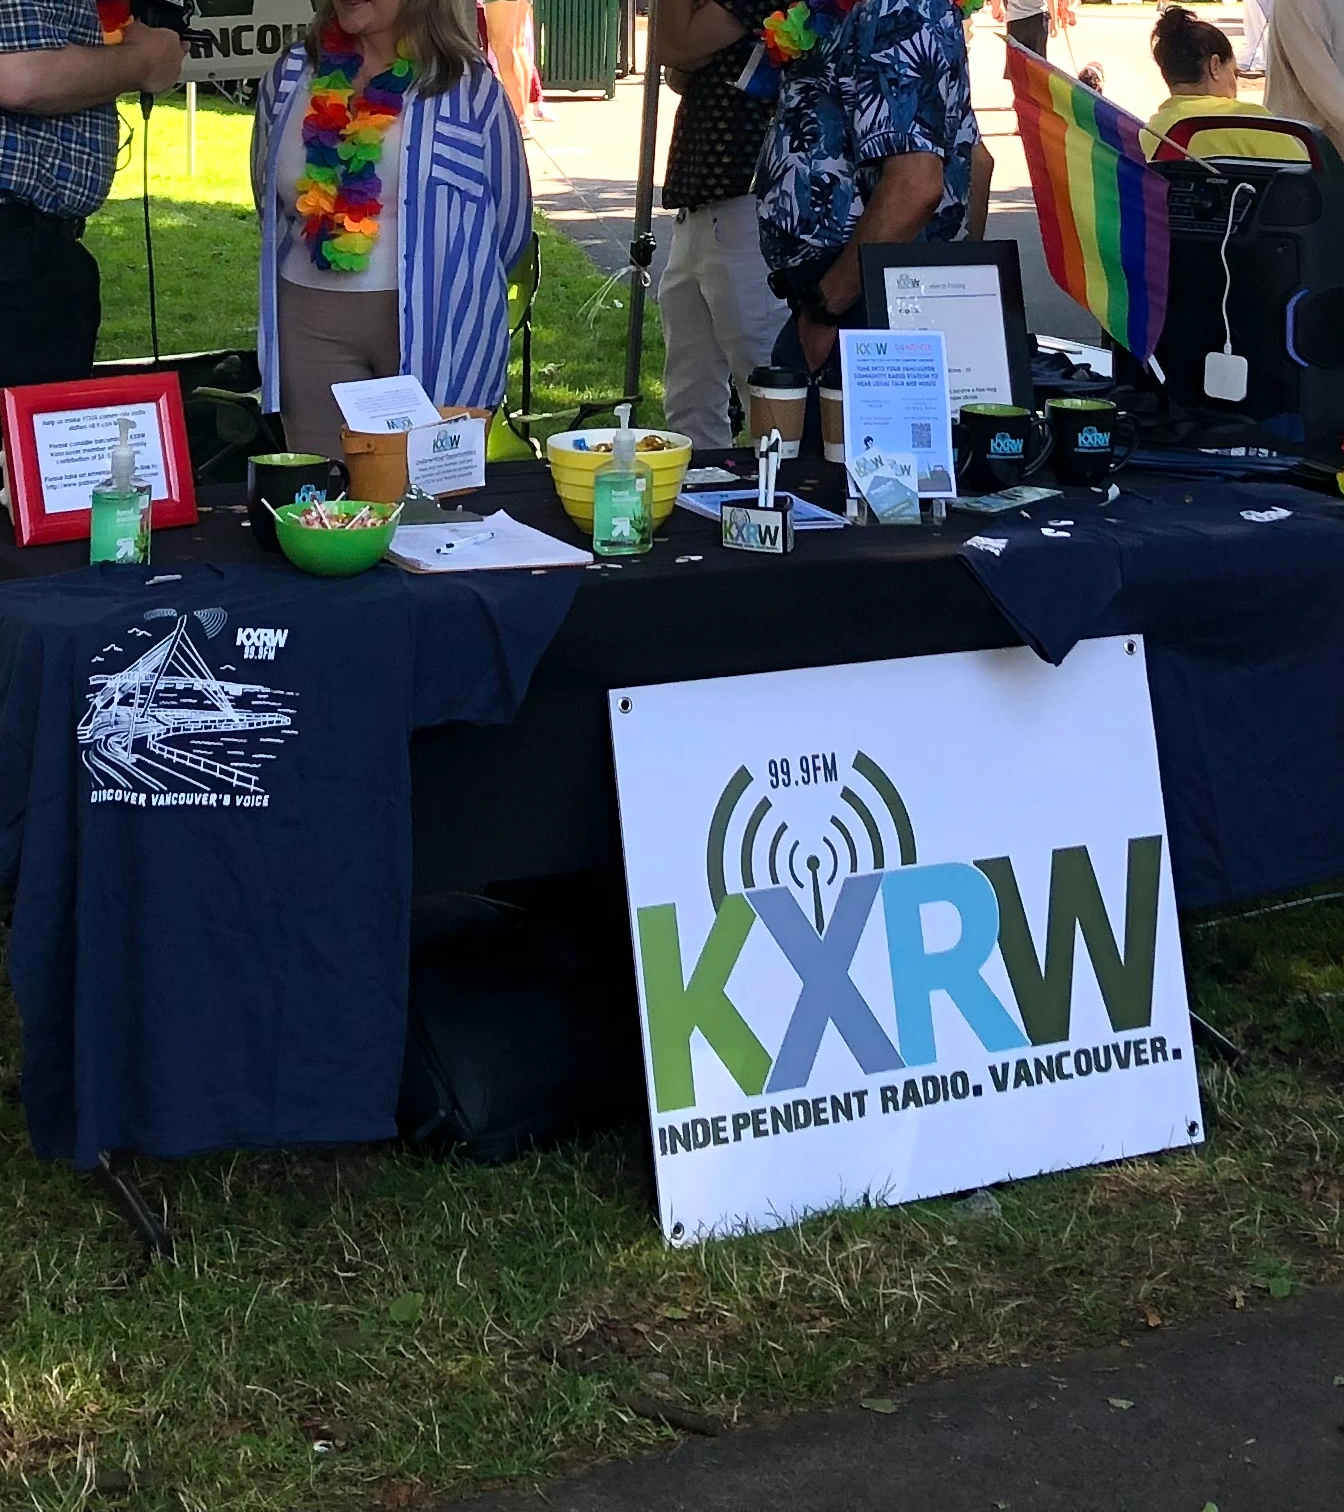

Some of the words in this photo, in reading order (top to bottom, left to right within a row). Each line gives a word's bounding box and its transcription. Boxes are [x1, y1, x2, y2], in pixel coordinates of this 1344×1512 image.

[236, 627, 289, 648] KXRW
[768, 751, 839, 790] 99.9FM
[90, 788, 147, 807] DISCOVER
[235, 794, 270, 808] VOICE
[636, 834, 1163, 1113] KXRW
[659, 1089, 869, 1156] INDEPENDENT
[881, 1069, 984, 1115] RADIO.
[988, 1036, 1183, 1092] VANCOUVER.
